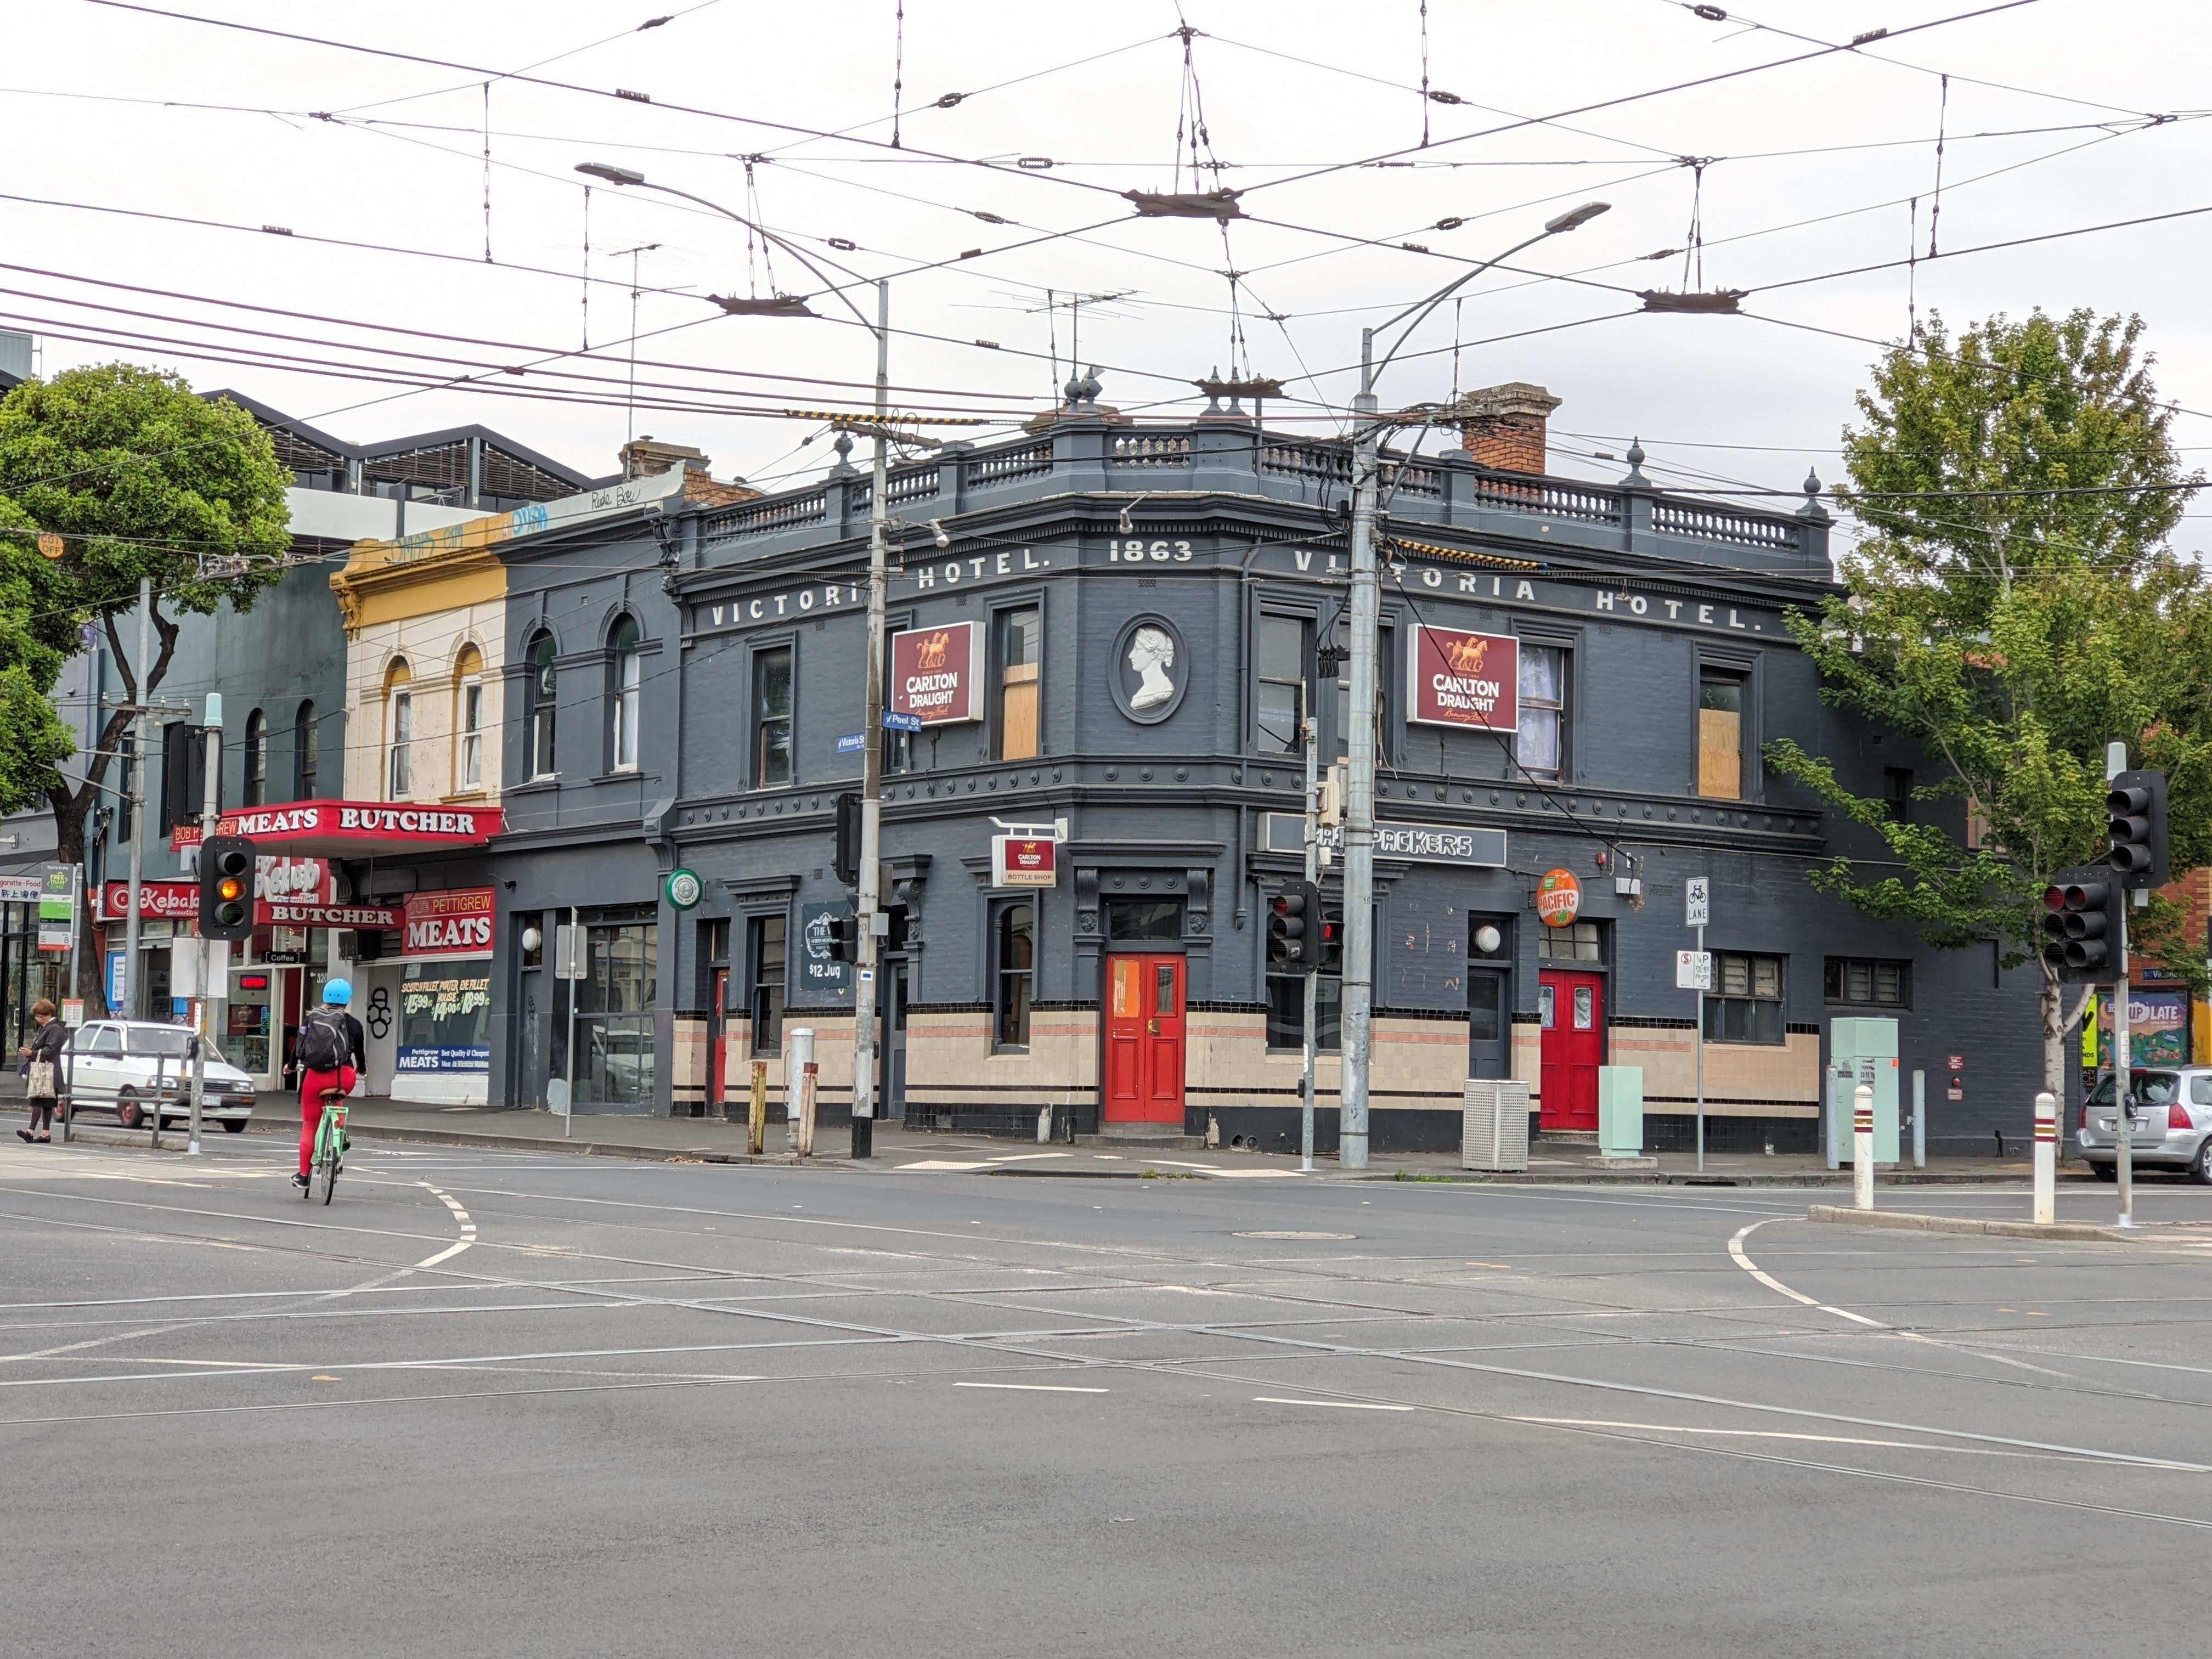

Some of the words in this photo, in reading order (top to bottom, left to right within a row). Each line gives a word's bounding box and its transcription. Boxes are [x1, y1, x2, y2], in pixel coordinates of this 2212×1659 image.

[41, 535, 60, 545] CUT
[42, 545, 60, 554] OFF
[1109, 540, 1193, 562] 1863
[712, 582, 860, 626] VICTORI
[918, 549, 1051, 589] HOTEL.
[1294, 550, 1537, 601] VITORIA
[1596, 590, 1761, 631] HOTEL.
[906, 672, 958, 693] CARLTON
[1432, 673, 1500, 697] CARLTON
[910, 691, 953, 708] DRAUGHT
[1437, 692, 1494, 712] DRAUGHT
[893, 715, 909, 724] Peel
[911, 716, 919, 726] St
[842, 736, 859, 746] Victoria
[859, 735, 865, 744] St
[236, 808, 318, 835] MEATS
[340, 808, 476, 834] BUTCHER
[175, 826, 190, 840] BOB
[1, 889, 41, 899] 新上海便
[139, 888, 200, 913] Kebab
[1538, 892, 1575, 912] PACIFIC
[433, 895, 491, 913] PETTIGREW
[272, 906, 395, 925] BUTCHER
[1689, 909, 1707, 920] LANE
[408, 917, 491, 948] MEATS
[813, 926, 826, 936] THE
[809, 963, 822, 978] $12
[824, 964, 840, 979] Jug
[439, 979, 459, 994] PORTER
[2130, 1007, 2143, 1020] UP
[2151, 1006, 2178, 1020] LATE
[450, 1049, 466, 1058] Quality
[399, 1056, 439, 1068] MEATS
